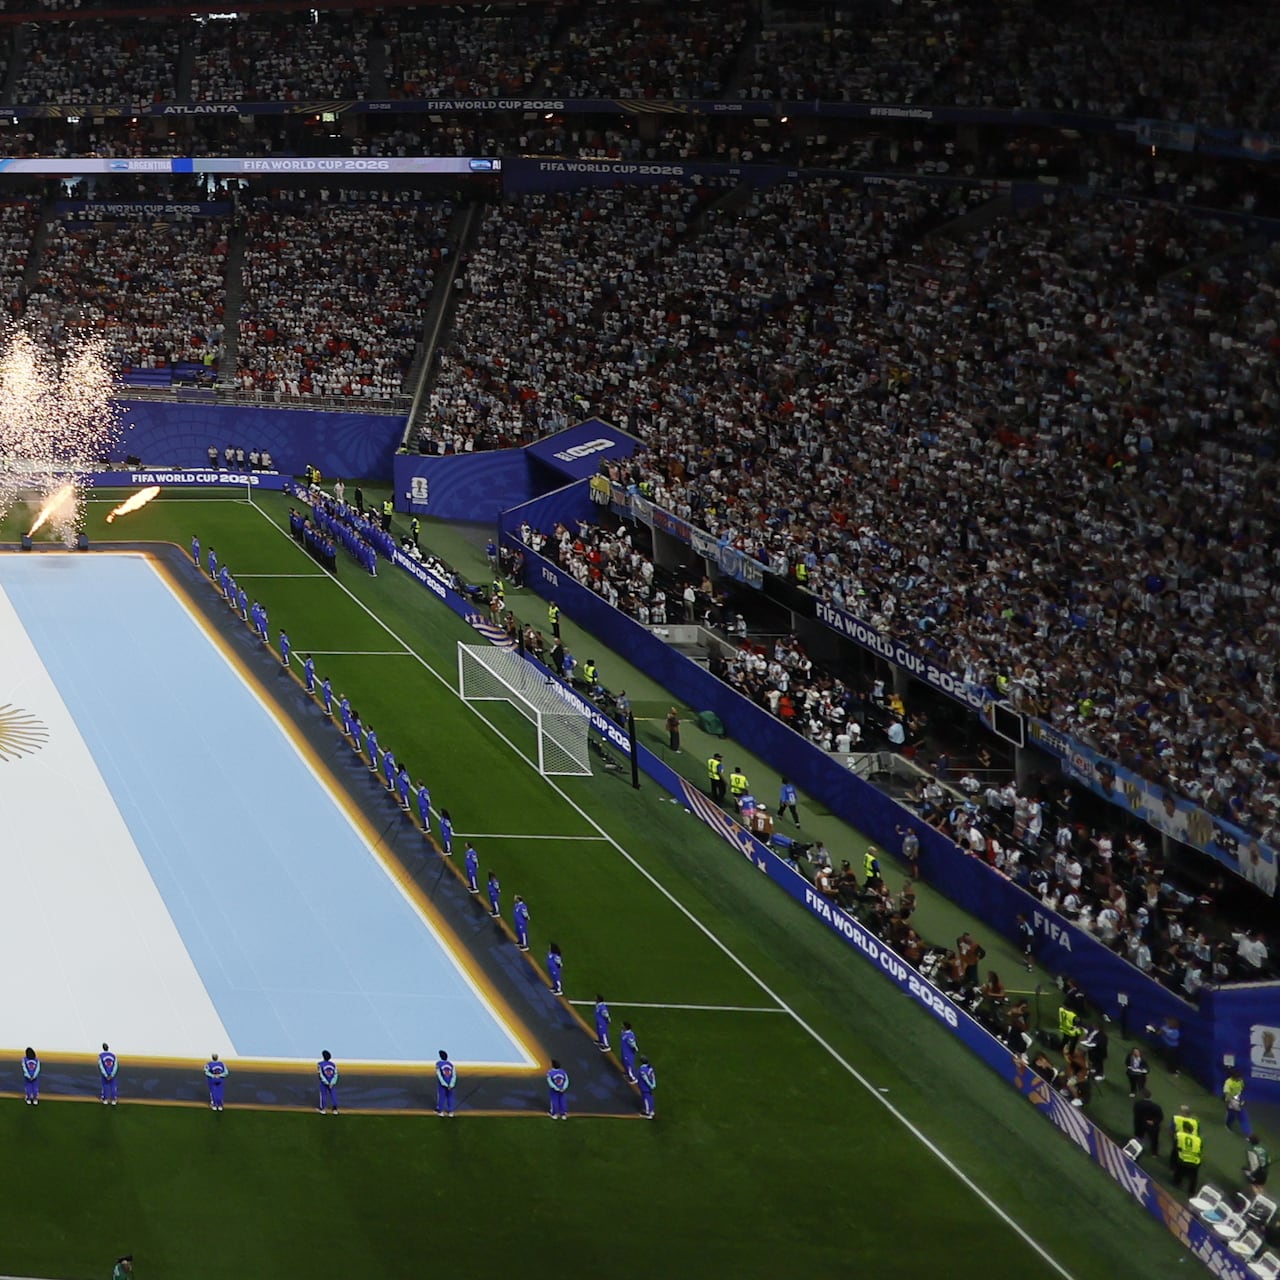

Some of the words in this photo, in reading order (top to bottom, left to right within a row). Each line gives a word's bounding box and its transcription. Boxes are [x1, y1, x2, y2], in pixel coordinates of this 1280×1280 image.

[163, 104, 239, 115] ATLANTA
[427, 101, 453, 111] FIFA
[454, 101, 497, 110] WORLD
[497, 100, 522, 110] CUP
[522, 100, 565, 110] 2026
[243, 161, 269, 170] FIFA
[269, 161, 316, 170] WORLD
[316, 161, 343, 170] CUP
[343, 161, 390, 170] 2026
[539, 162, 566, 172] FIFA
[566, 163, 612, 173] WORLD
[612, 164, 638, 174] CUP
[638, 165, 685, 175] 2026
[143, 204, 164, 213] CUP
[164, 204, 201, 213] 2026
[131, 473, 155, 483] FIFA
[155, 473, 196, 483] WORLD
[196, 473, 219, 483] CUP
[219, 474, 260, 485] 2026
[397, 554, 416, 574] WORLD
[426, 578, 447, 599] 2026
[541, 566, 559, 587] FIFA
[816, 601, 843, 631] FIFA
[844, 617, 894, 658] WORLD
[895, 648, 925, 674] CUP
[564, 688, 592, 719] WORLD
[607, 726, 632, 753] 202
[1033, 910, 1073, 953] FIFA
[805, 888, 832, 922] FIFA
[832, 910, 879, 960] WORLD
[880, 951, 908, 982] CUP
[908, 975, 959, 1028] 2026
